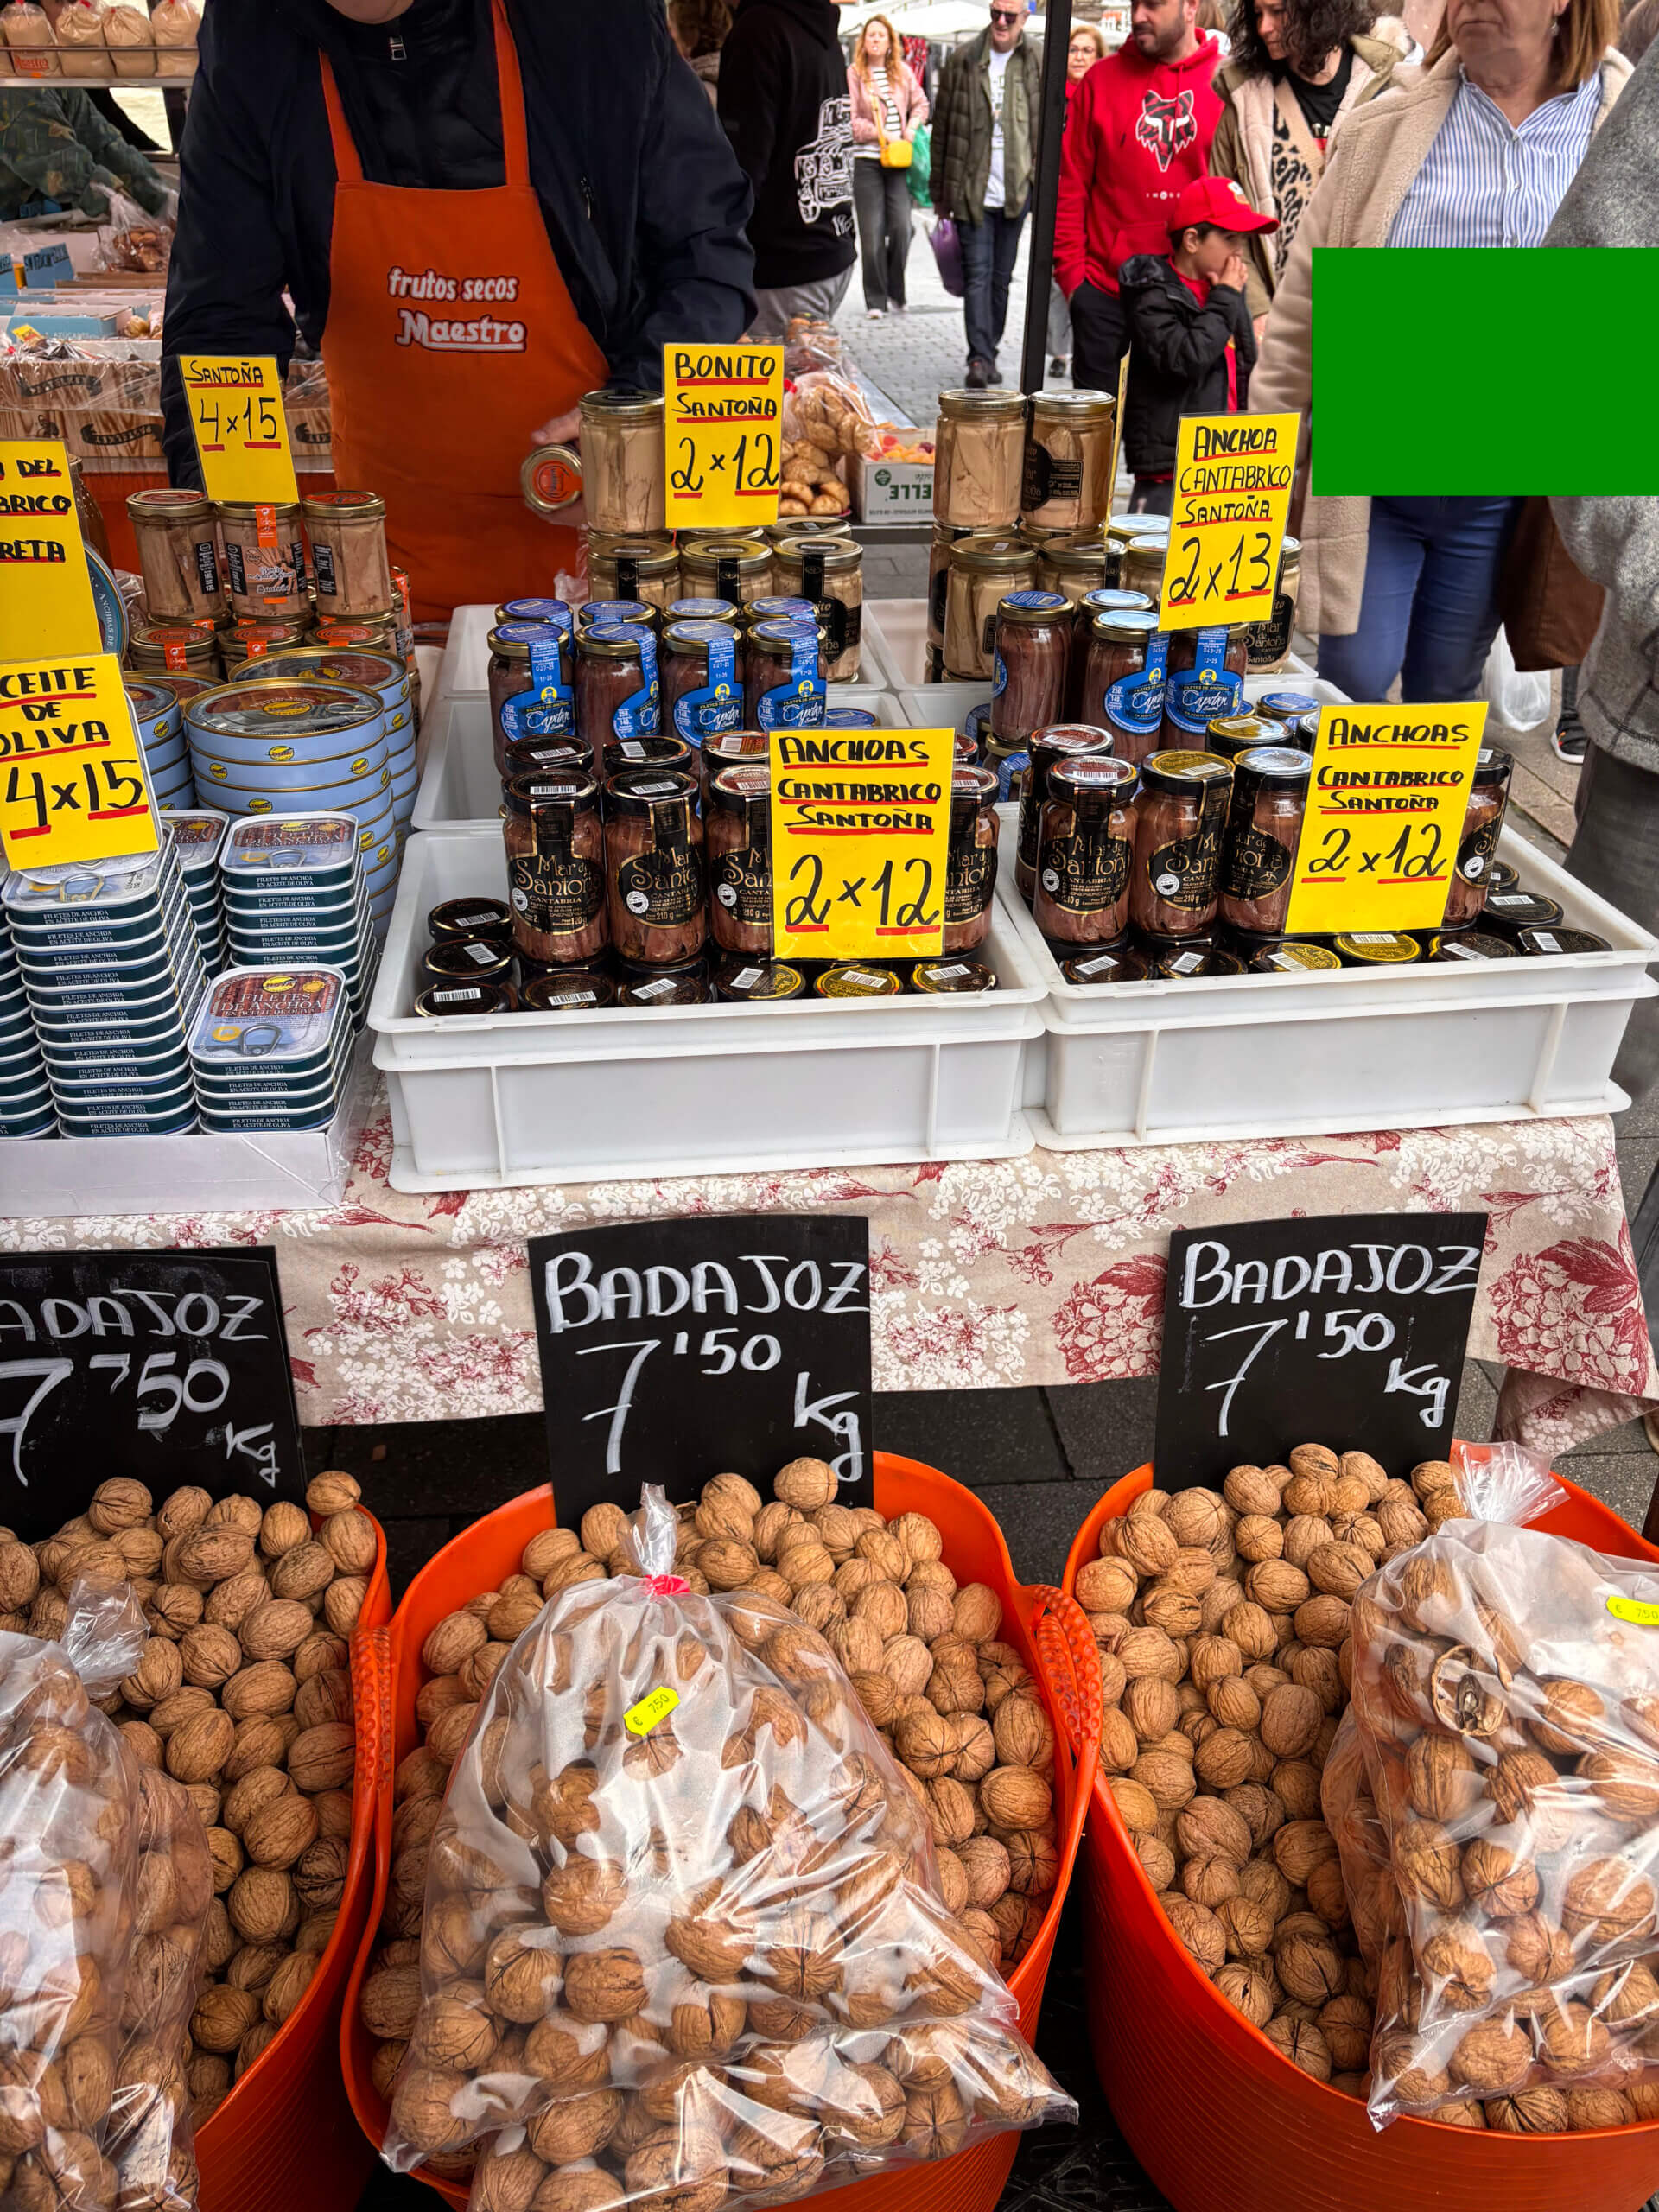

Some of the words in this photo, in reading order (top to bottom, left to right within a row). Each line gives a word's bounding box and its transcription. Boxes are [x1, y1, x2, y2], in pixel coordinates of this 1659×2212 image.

[389, 267, 457, 300] frutos
[462, 277, 518, 301] secos
[395, 309, 525, 351] Maestro
[184, 360, 263, 384] SANTOÑA
[675, 353, 776, 378] BONITO
[671, 392, 777, 416] SANTOÑA
[1193, 426, 1278, 461] ANCHOA
[16, 459, 62, 476] DEL
[1180, 465, 1292, 493] CANTABRICO
[1176, 495, 1270, 525] SANTOÑA
[0, 668, 96, 698] CEITE
[22, 702, 62, 721] DE
[1328, 718, 1470, 745] ANCHOAS
[779, 736, 930, 763] ANCHOAS
[1317, 766, 1464, 786] CANTABRICO
[778, 778, 942, 803] CANTABRICO
[1317, 791, 1439, 810] SANTOÑA
[783, 804, 933, 830] SANTOÑA
[221, 1002, 244, 1012] DE
[251, 1000, 322, 1011] ANCHOA
[241, 993, 311, 1003] FILETES
[1179, 1240, 1481, 1308] BADAJOZ
[545, 1252, 870, 1333] BADAJOZ
[0, 1288, 269, 1341] ADAJOZ
[1384, 1357, 1450, 1427] Kg
[793, 1371, 864, 1483] Kg
[225, 1422, 280, 1487] Kg
